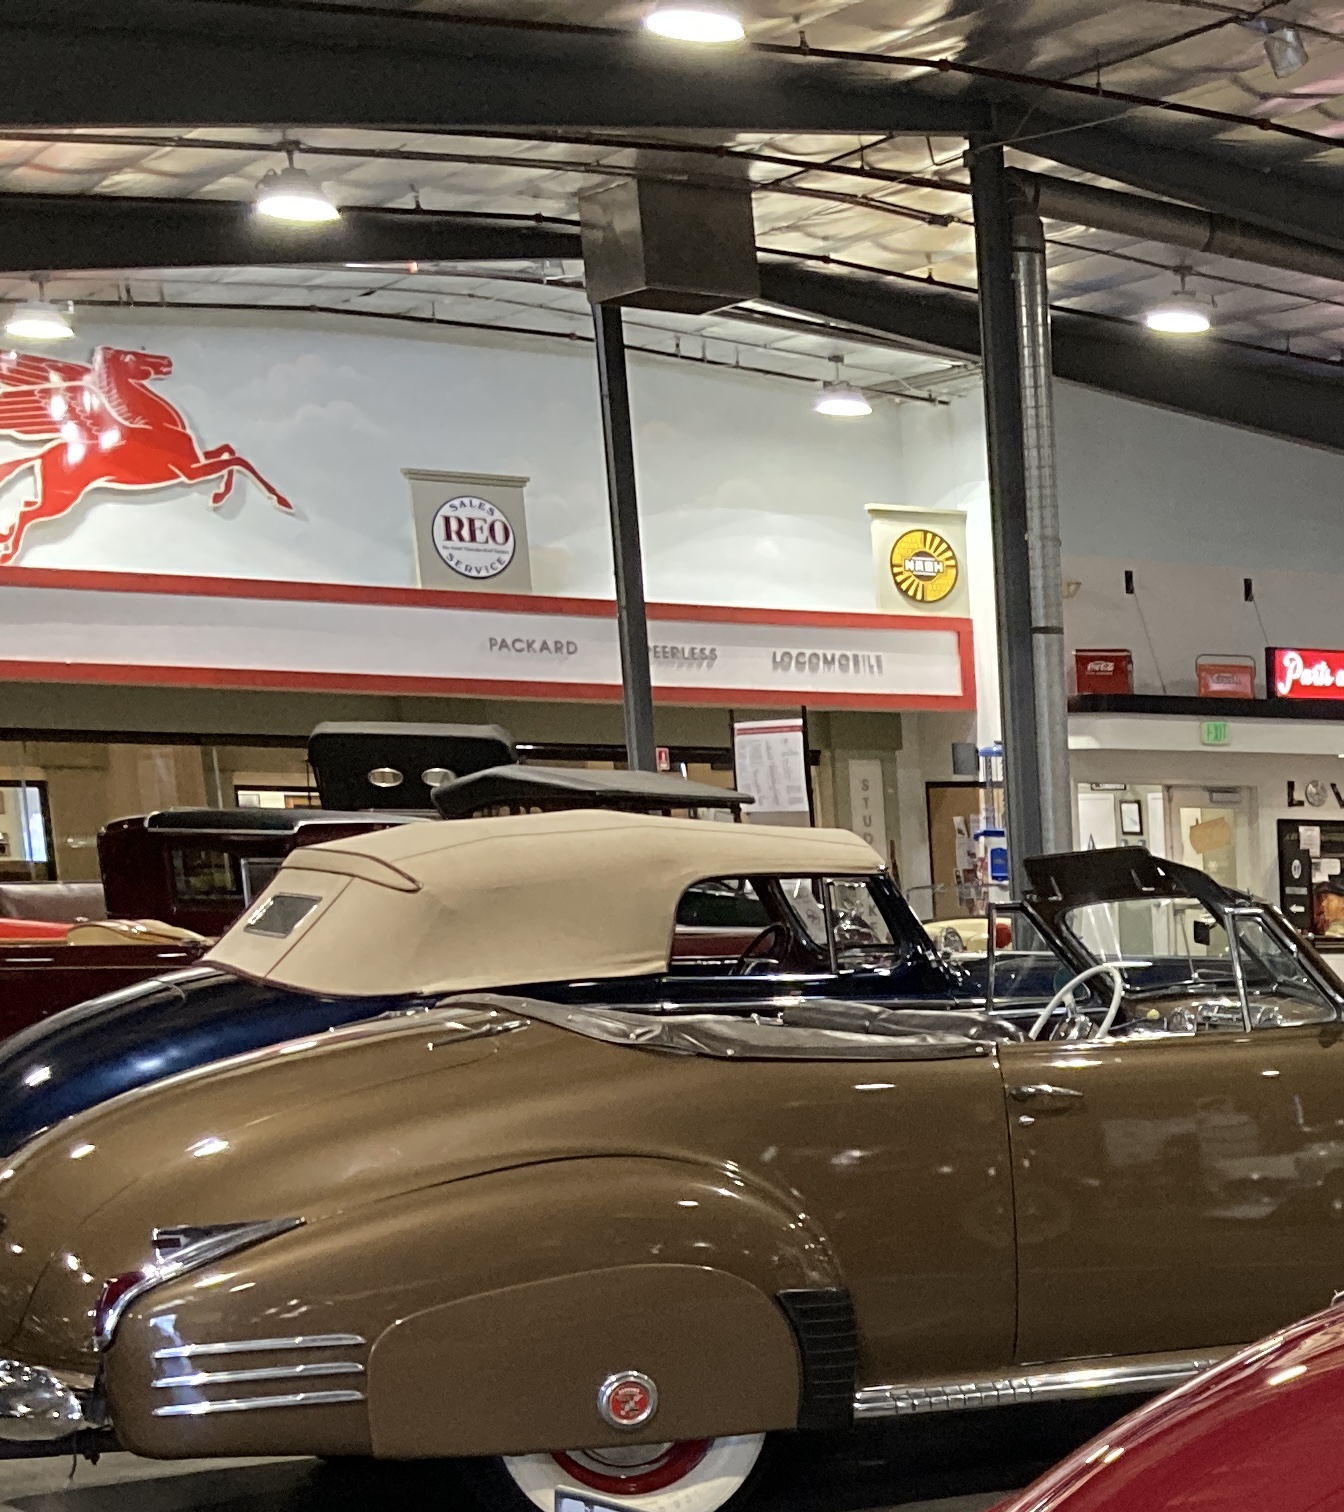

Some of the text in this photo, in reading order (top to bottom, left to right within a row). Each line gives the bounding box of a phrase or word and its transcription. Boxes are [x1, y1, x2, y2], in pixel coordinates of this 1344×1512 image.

[449, 499, 495, 516] SALES
[440, 515, 510, 546] REO
[446, 552, 506, 575] SERVICE
[904, 559, 944, 573] NASH
[488, 637, 579, 656] PACKARD
[648, 645, 718, 662] EERLESS
[771, 650, 884, 673] LOCOMOBILE
[1277, 651, 1335, 695] Parts
[1206, 722, 1227, 742] EXIT
